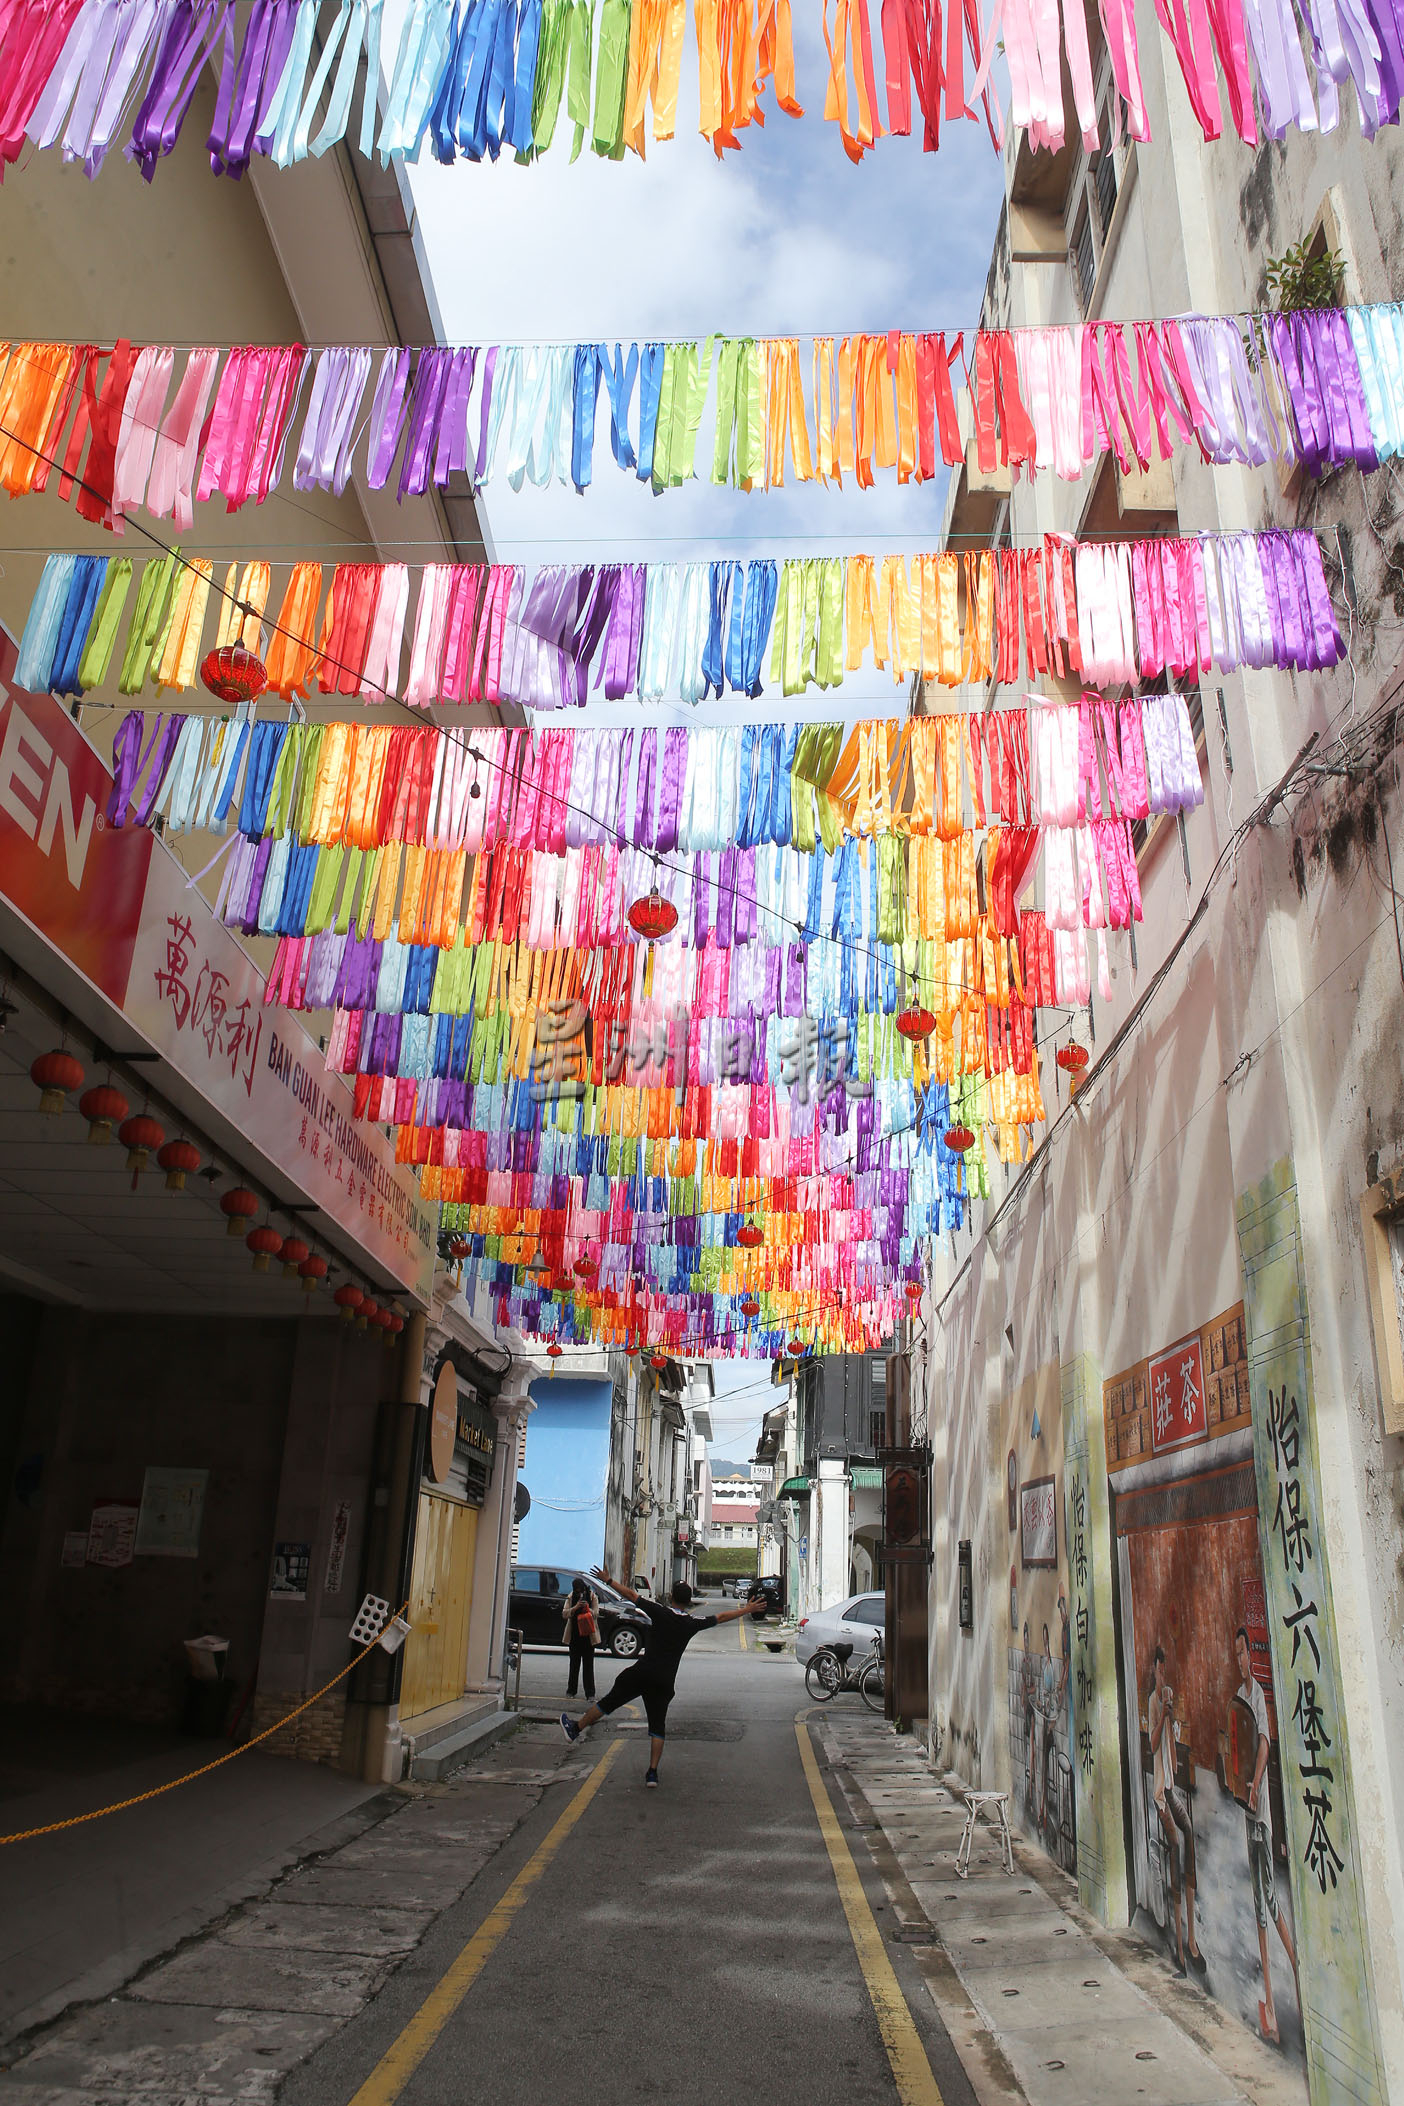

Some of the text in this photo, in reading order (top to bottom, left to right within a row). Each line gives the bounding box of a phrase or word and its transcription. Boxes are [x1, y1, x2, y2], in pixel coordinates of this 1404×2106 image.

[0, 682, 96, 891] EN
[154, 912, 262, 1098] 萬源利
[268, 1031, 431, 1250] BAN GUAN LEE HARDWARE ELECTRIC SDN. BHD.
[459, 1415, 480, 1447] Market
[481, 1430, 493, 1455] Lane
[752, 1466, 771, 1474] 1981
[1070, 1474, 1094, 1777] 怡保白咖啡
[1266, 1383, 1344, 1895] 怡保六堡茶
